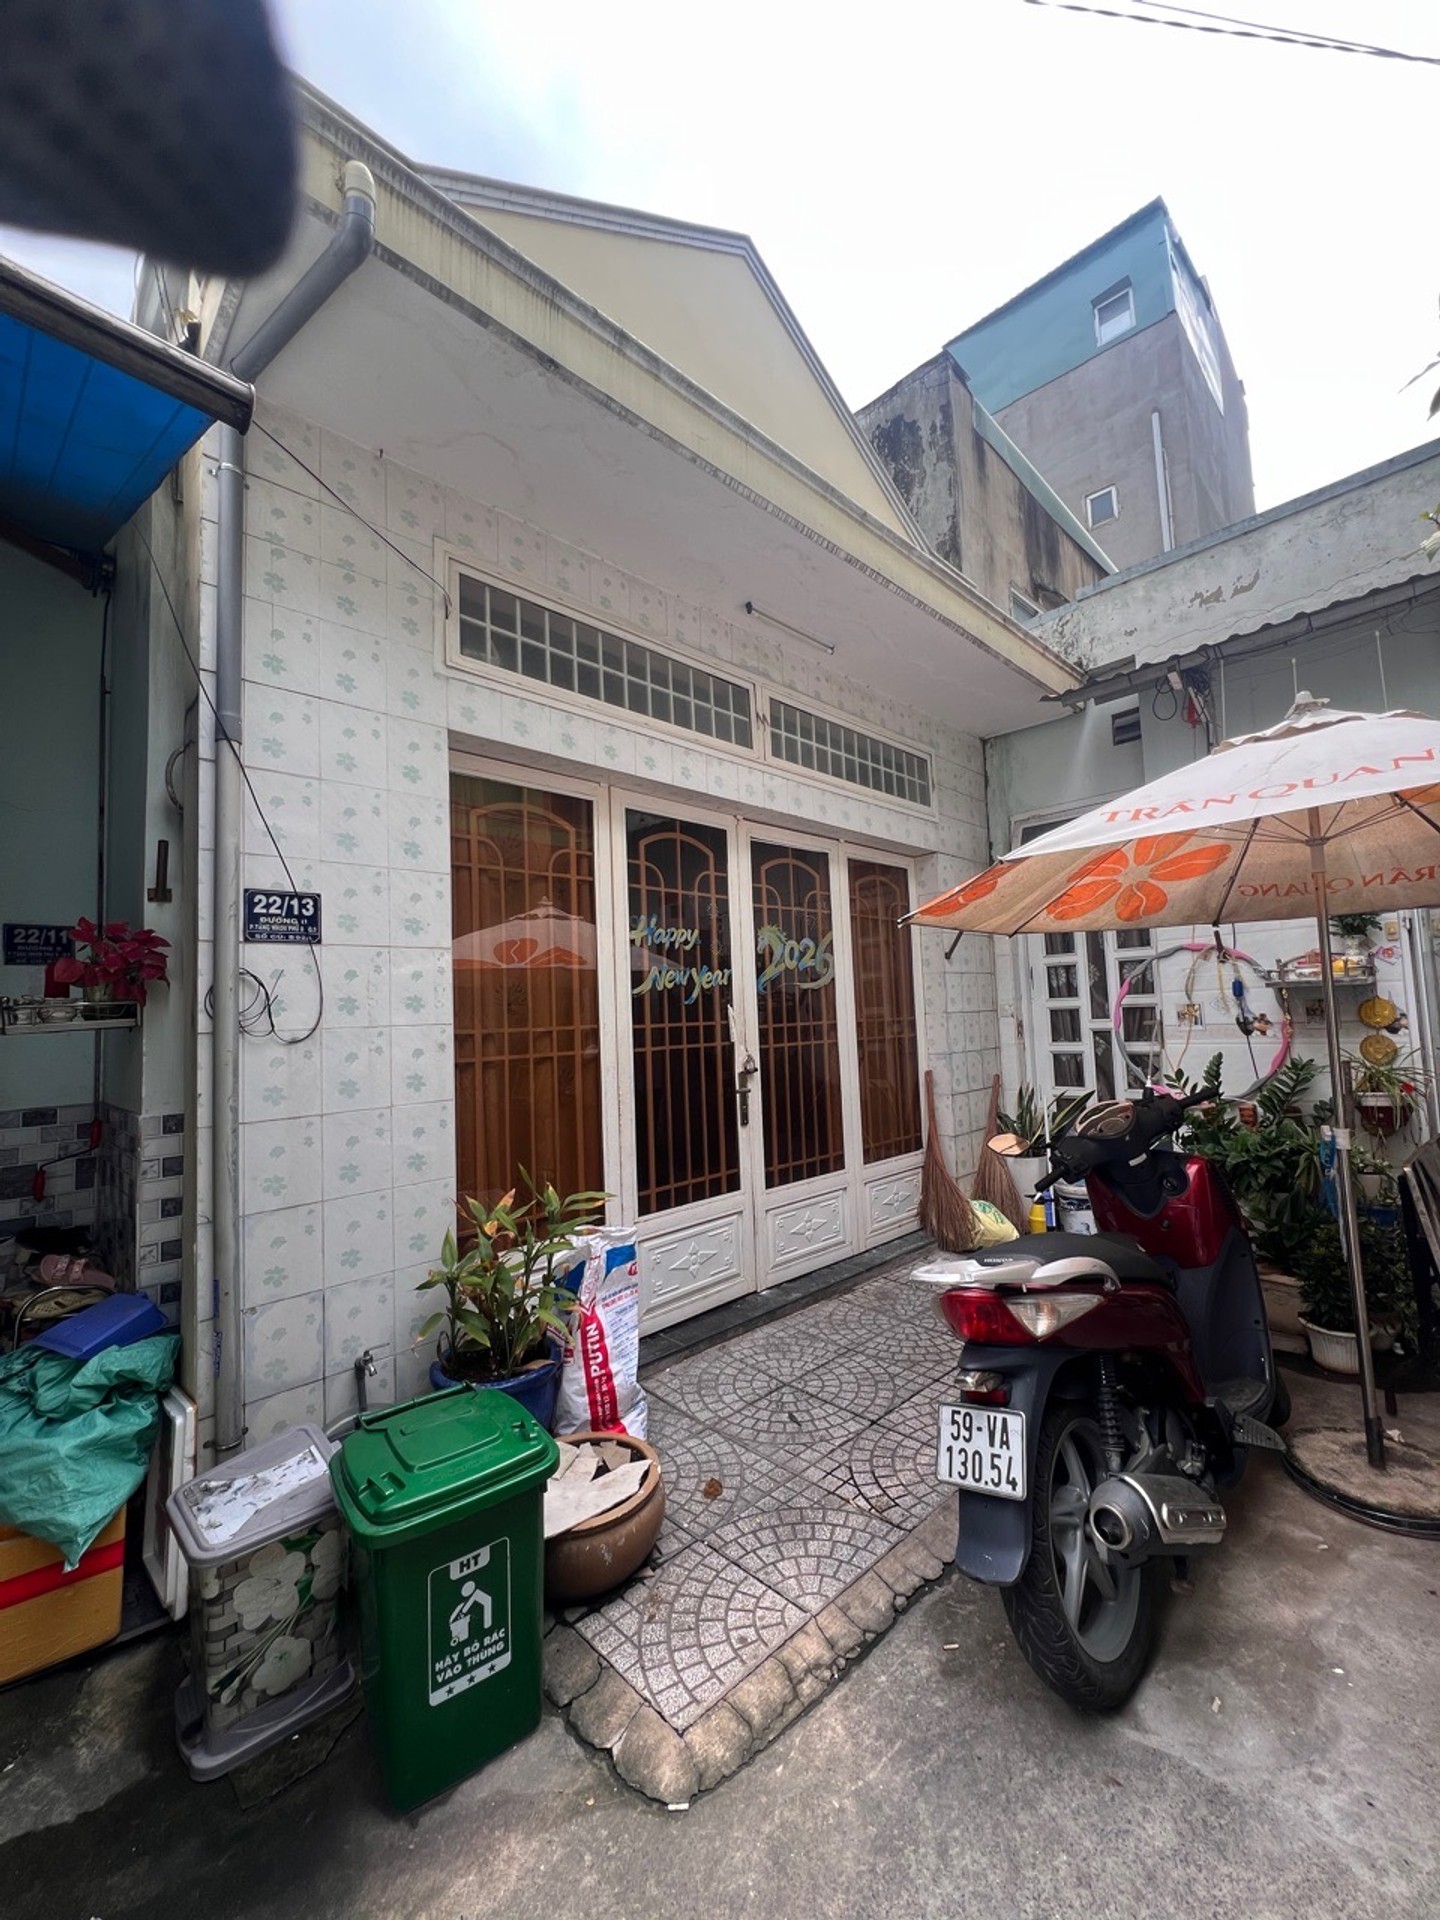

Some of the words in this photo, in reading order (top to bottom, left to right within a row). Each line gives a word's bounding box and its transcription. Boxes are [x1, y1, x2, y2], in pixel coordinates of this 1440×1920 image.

[1248, 748, 1438, 799] QUAN
[253, 894, 315, 917] 22/13
[13, 928, 68, 945] 22/11
[629, 913, 701, 951] Happy
[632, 964, 690, 995] New
[684, 964, 732, 1005] Year
[950, 1409, 1010, 1451] 59-VA
[946, 1445, 1018, 1492] 130.54
[458, 1553, 482, 1575] HT
